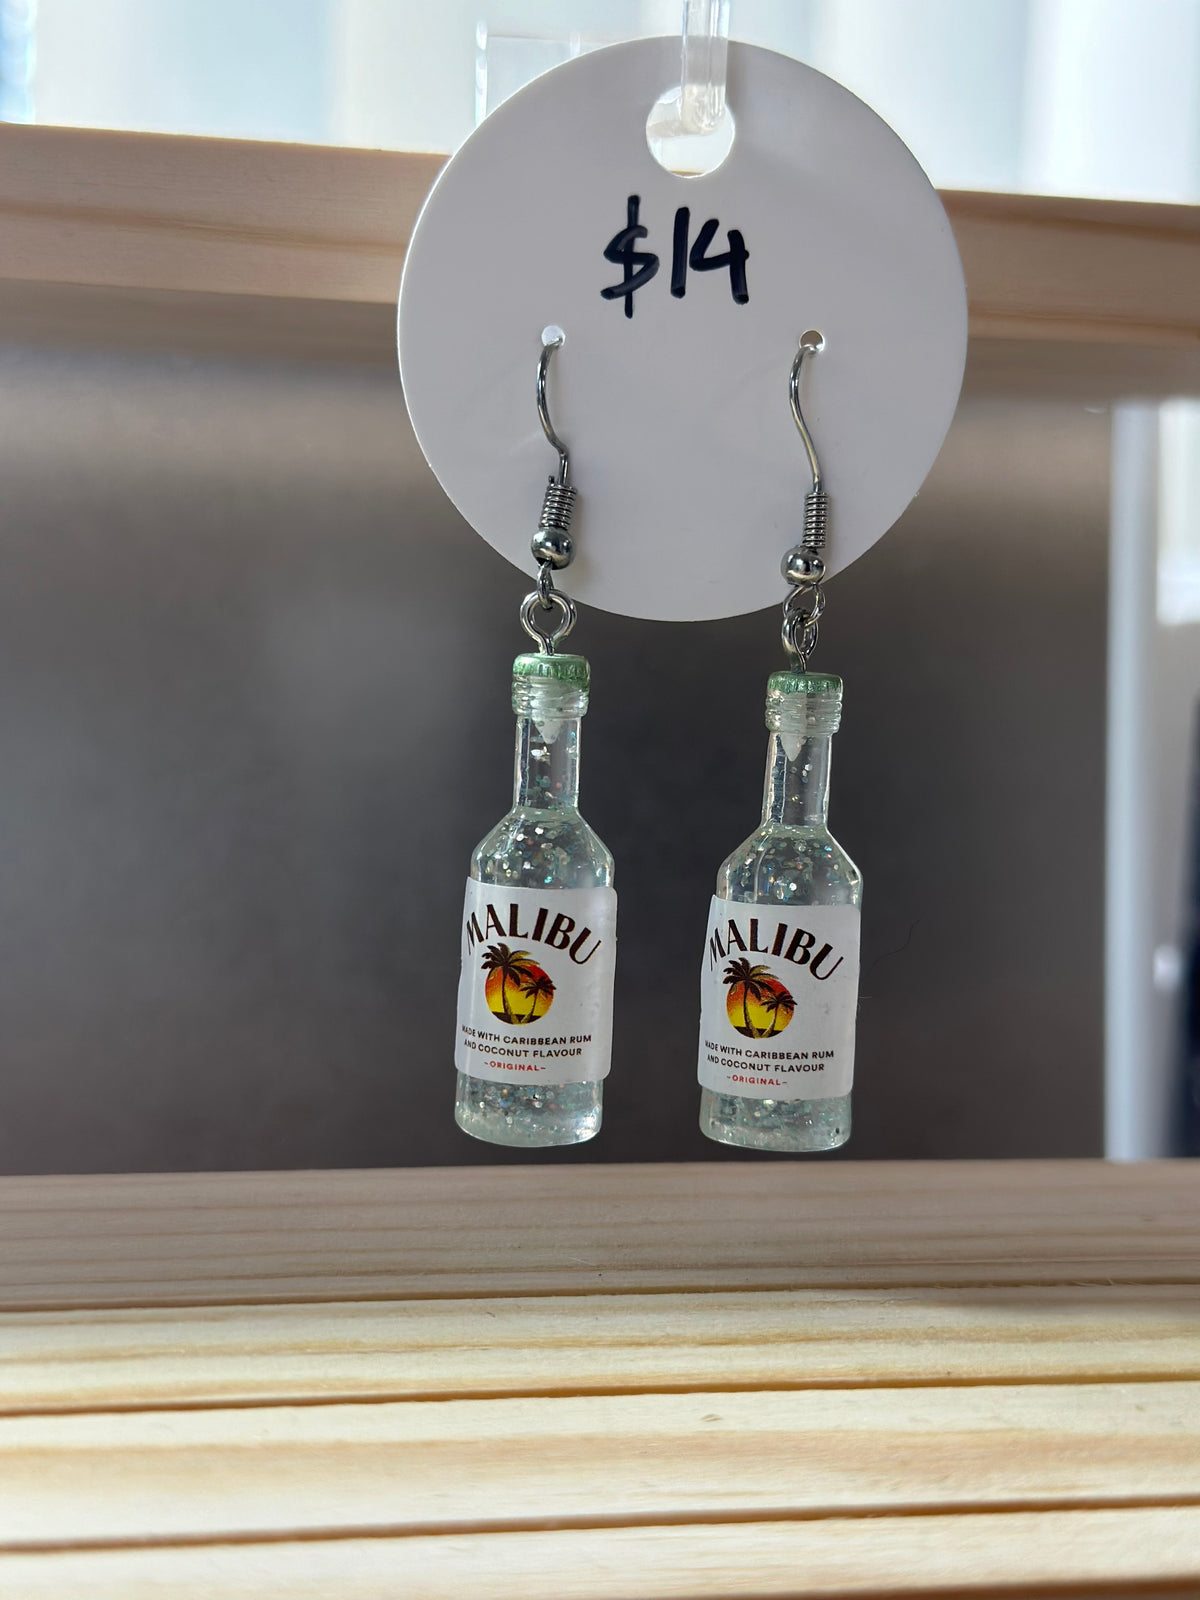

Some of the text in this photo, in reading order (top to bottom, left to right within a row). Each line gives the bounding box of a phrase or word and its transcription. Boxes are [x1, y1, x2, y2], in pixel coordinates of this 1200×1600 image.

[600, 194, 750, 319] $14
[466, 903, 602, 965] MALIBU
[709, 918, 844, 981] MALIBU
[462, 1025, 592, 1046] MADE WITH CARIBBEAN RUM
[464, 1038, 582, 1058] AND COCONUT FLAVOUR
[705, 1040, 835, 1060] MADE WITH CARIBBEAN RUM
[706, 1054, 825, 1073] AND COCONUT FLAVOUR
